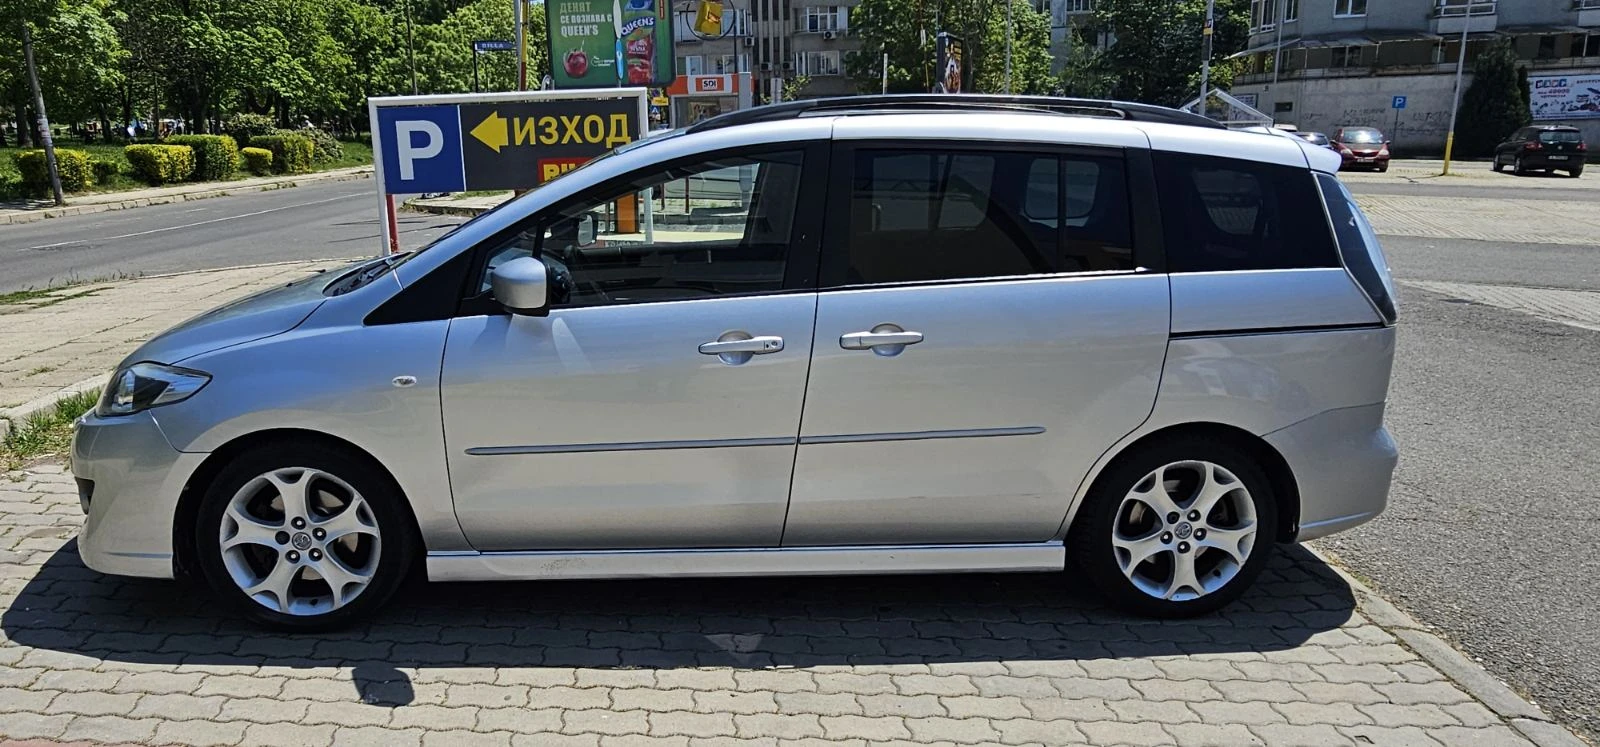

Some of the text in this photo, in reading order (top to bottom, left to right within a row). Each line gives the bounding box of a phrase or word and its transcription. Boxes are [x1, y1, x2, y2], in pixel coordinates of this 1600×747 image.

[560, 15, 570, 24] СЕ
[571, 14, 606, 24] ПОЗНАВА
[561, 25, 599, 38] QUEEN'S
[703, 80, 717, 88] SDI
[1396, 97, 1404, 107] P
[513, 113, 632, 149] ИЗХОД
[395, 119, 444, 181] P
